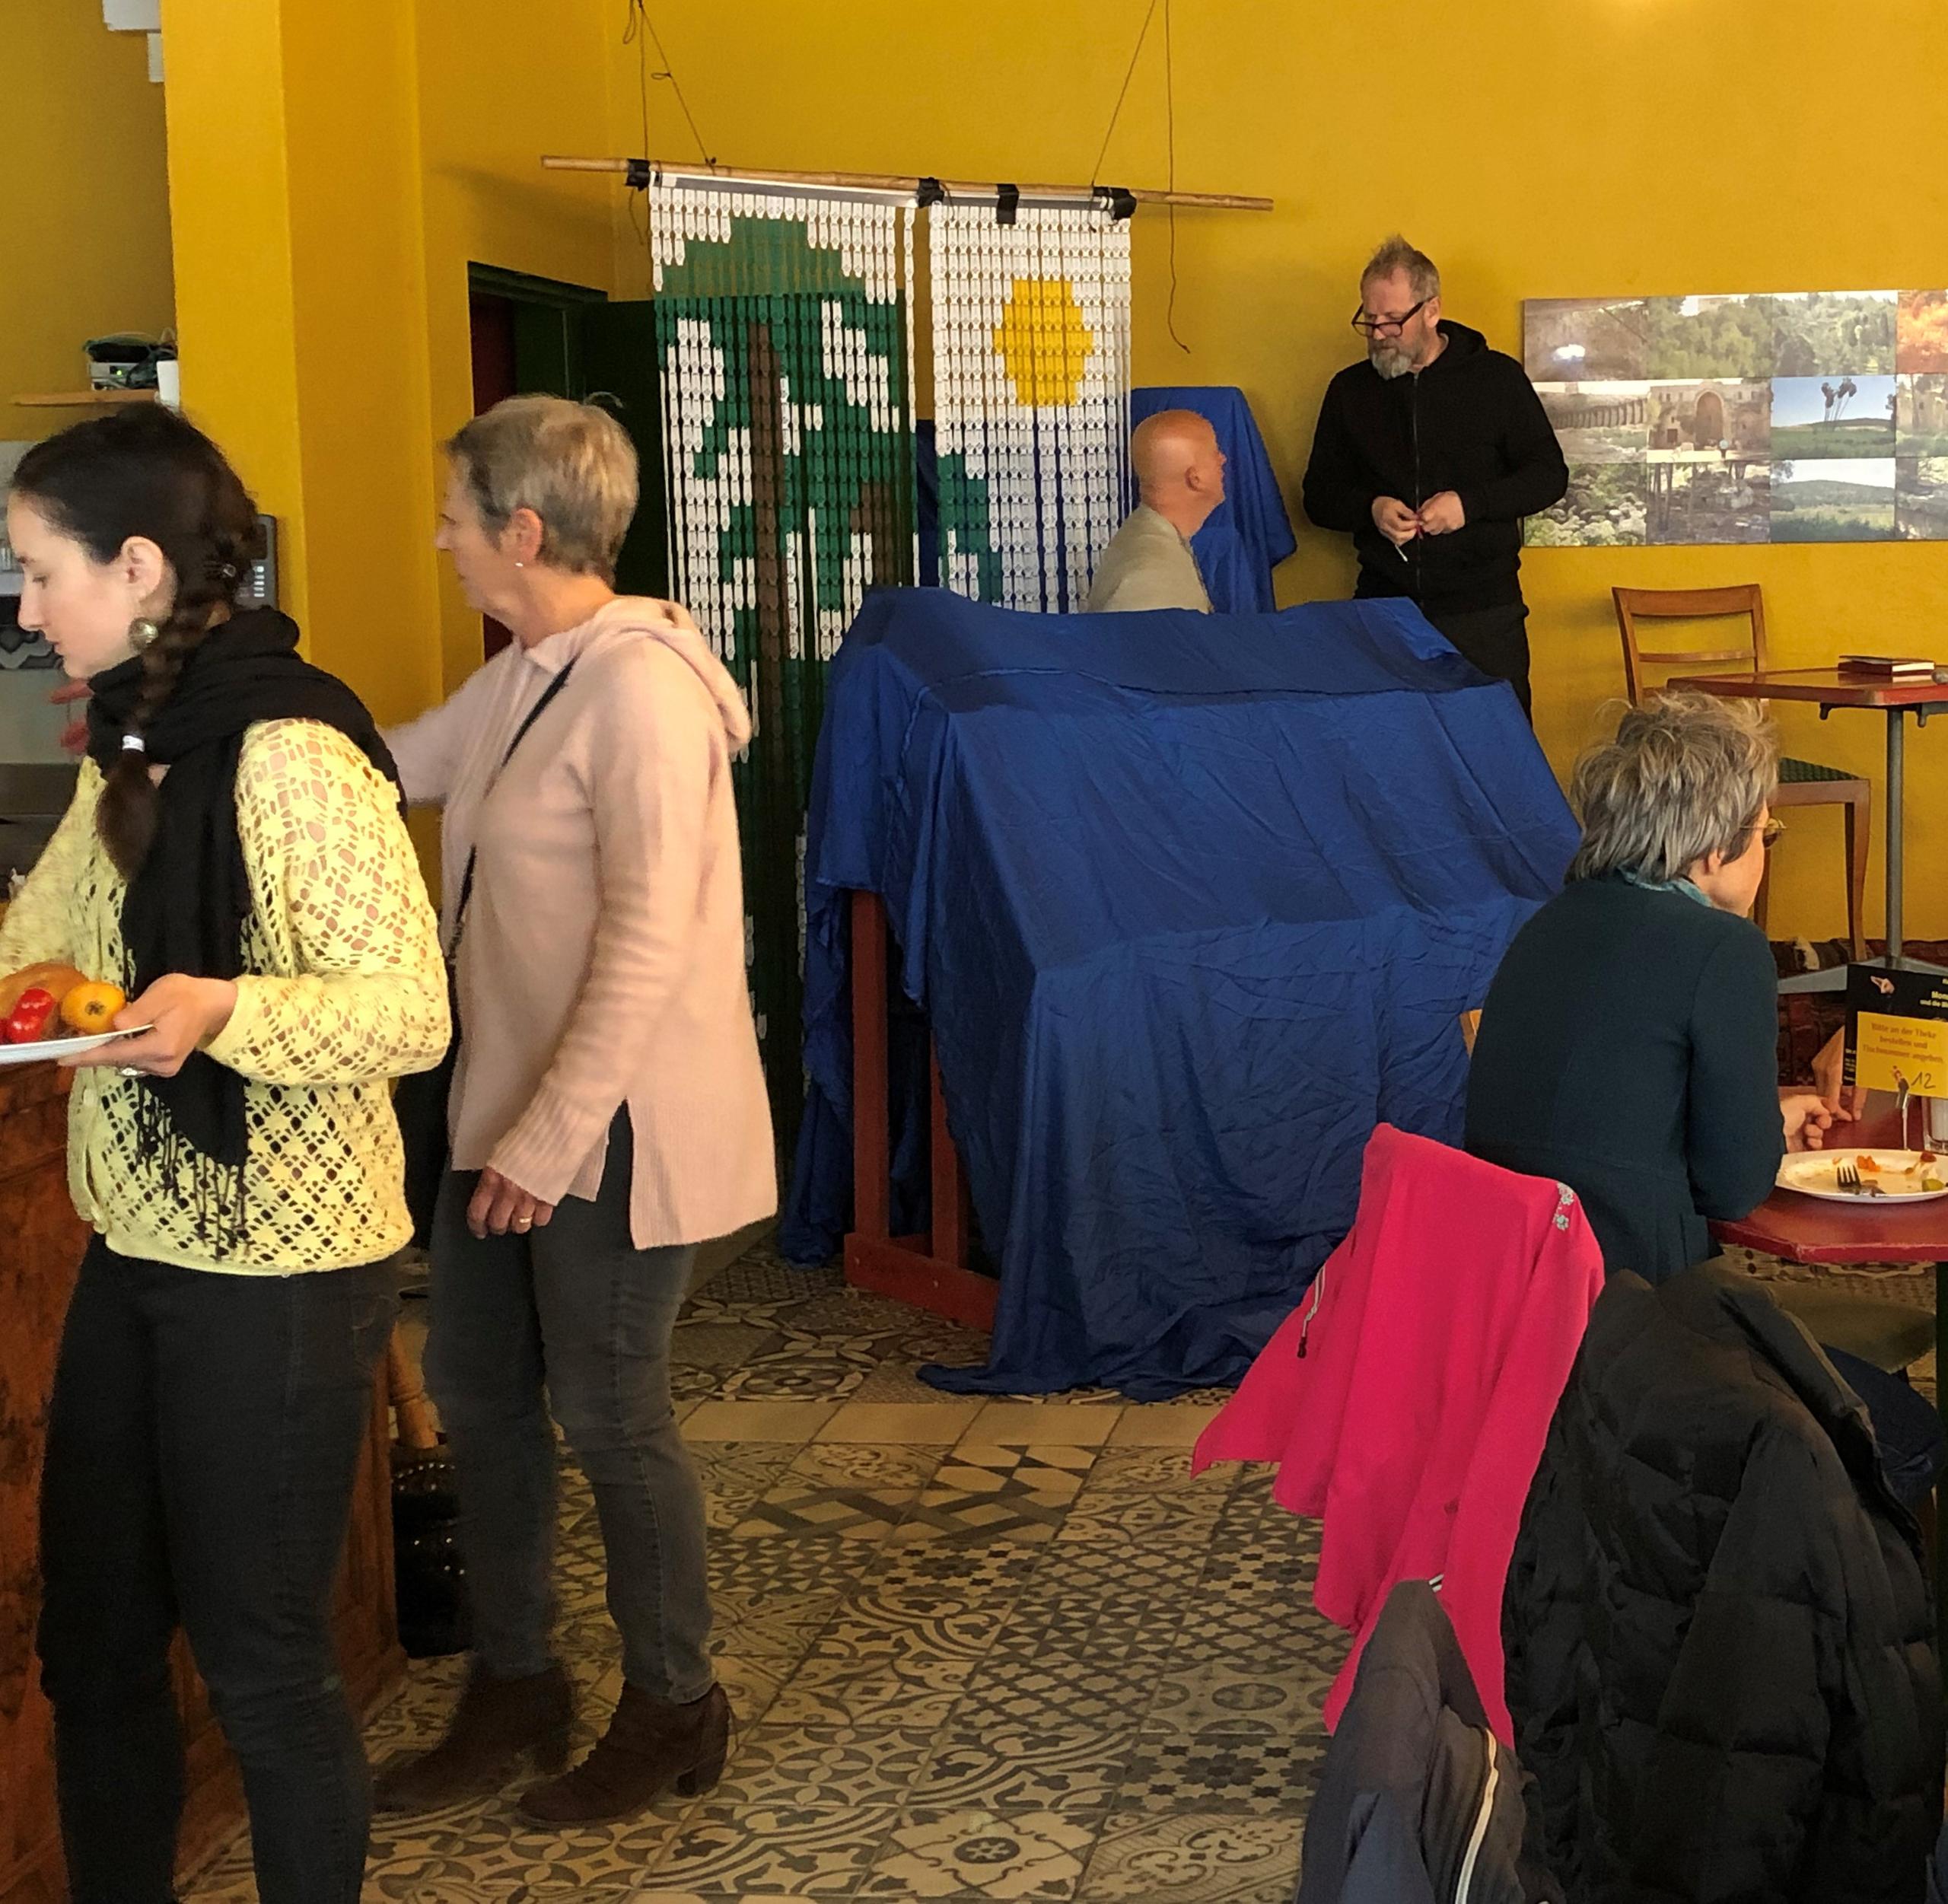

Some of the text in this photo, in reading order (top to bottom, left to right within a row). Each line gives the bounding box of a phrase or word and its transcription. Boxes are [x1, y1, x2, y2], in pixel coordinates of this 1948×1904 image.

[1871, 1023, 1889, 1033] Bitte
[1915, 1029, 1936, 1039] Theke
[1880, 1036, 1911, 1046] bestellen
[1911, 1071, 1936, 1089] 12
